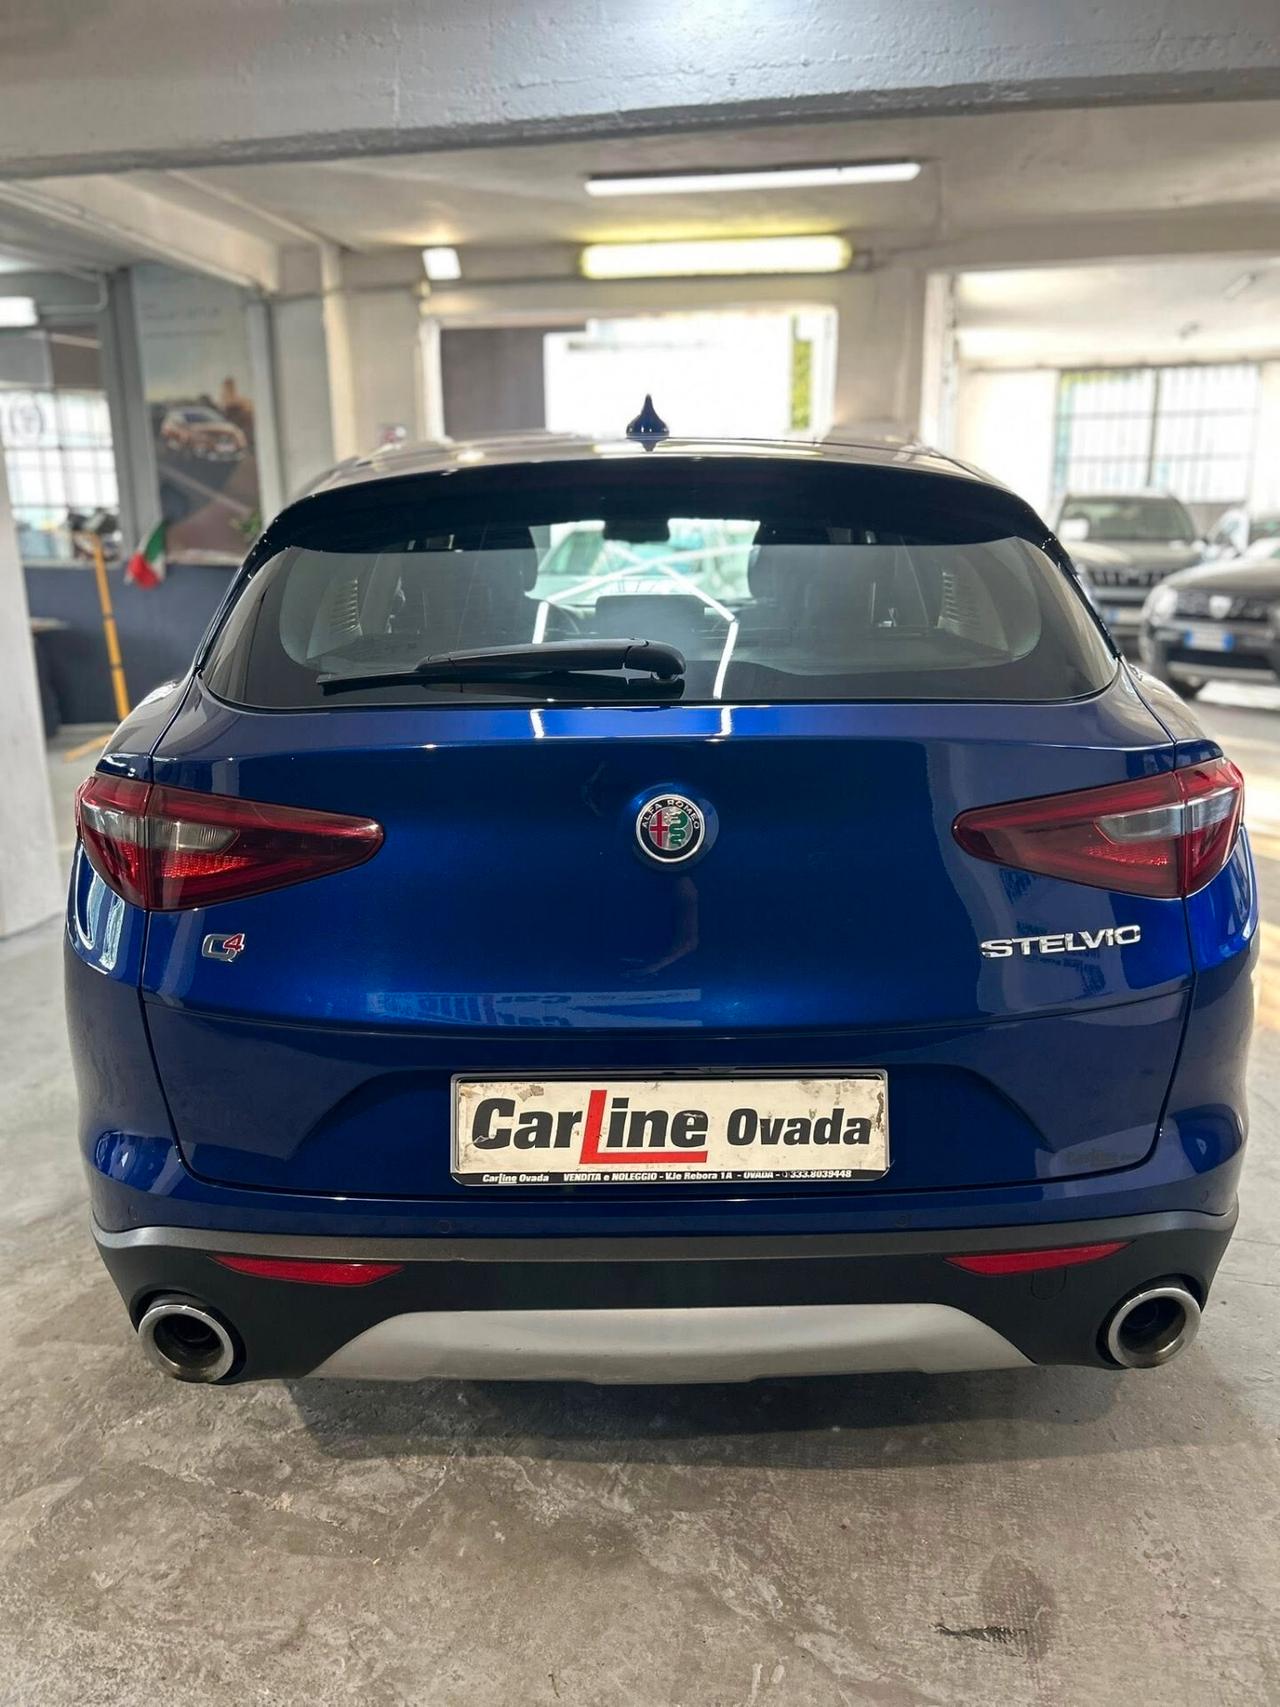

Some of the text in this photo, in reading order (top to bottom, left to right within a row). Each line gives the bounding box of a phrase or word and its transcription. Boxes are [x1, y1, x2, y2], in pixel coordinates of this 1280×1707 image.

[642, 799, 700, 830] ALFA ROMEO
[980, 924, 1142, 958] STELVIO
[727, 1108, 872, 1146] Ovada
[519, 1174, 550, 1183] Ovada
[563, 1173, 601, 1182] VENDITA
[611, 1172, 657, 1181] NOLEGGIO
[684, 1172, 718, 1180] Rebora
[743, 1171, 774, 1179] OVADA
